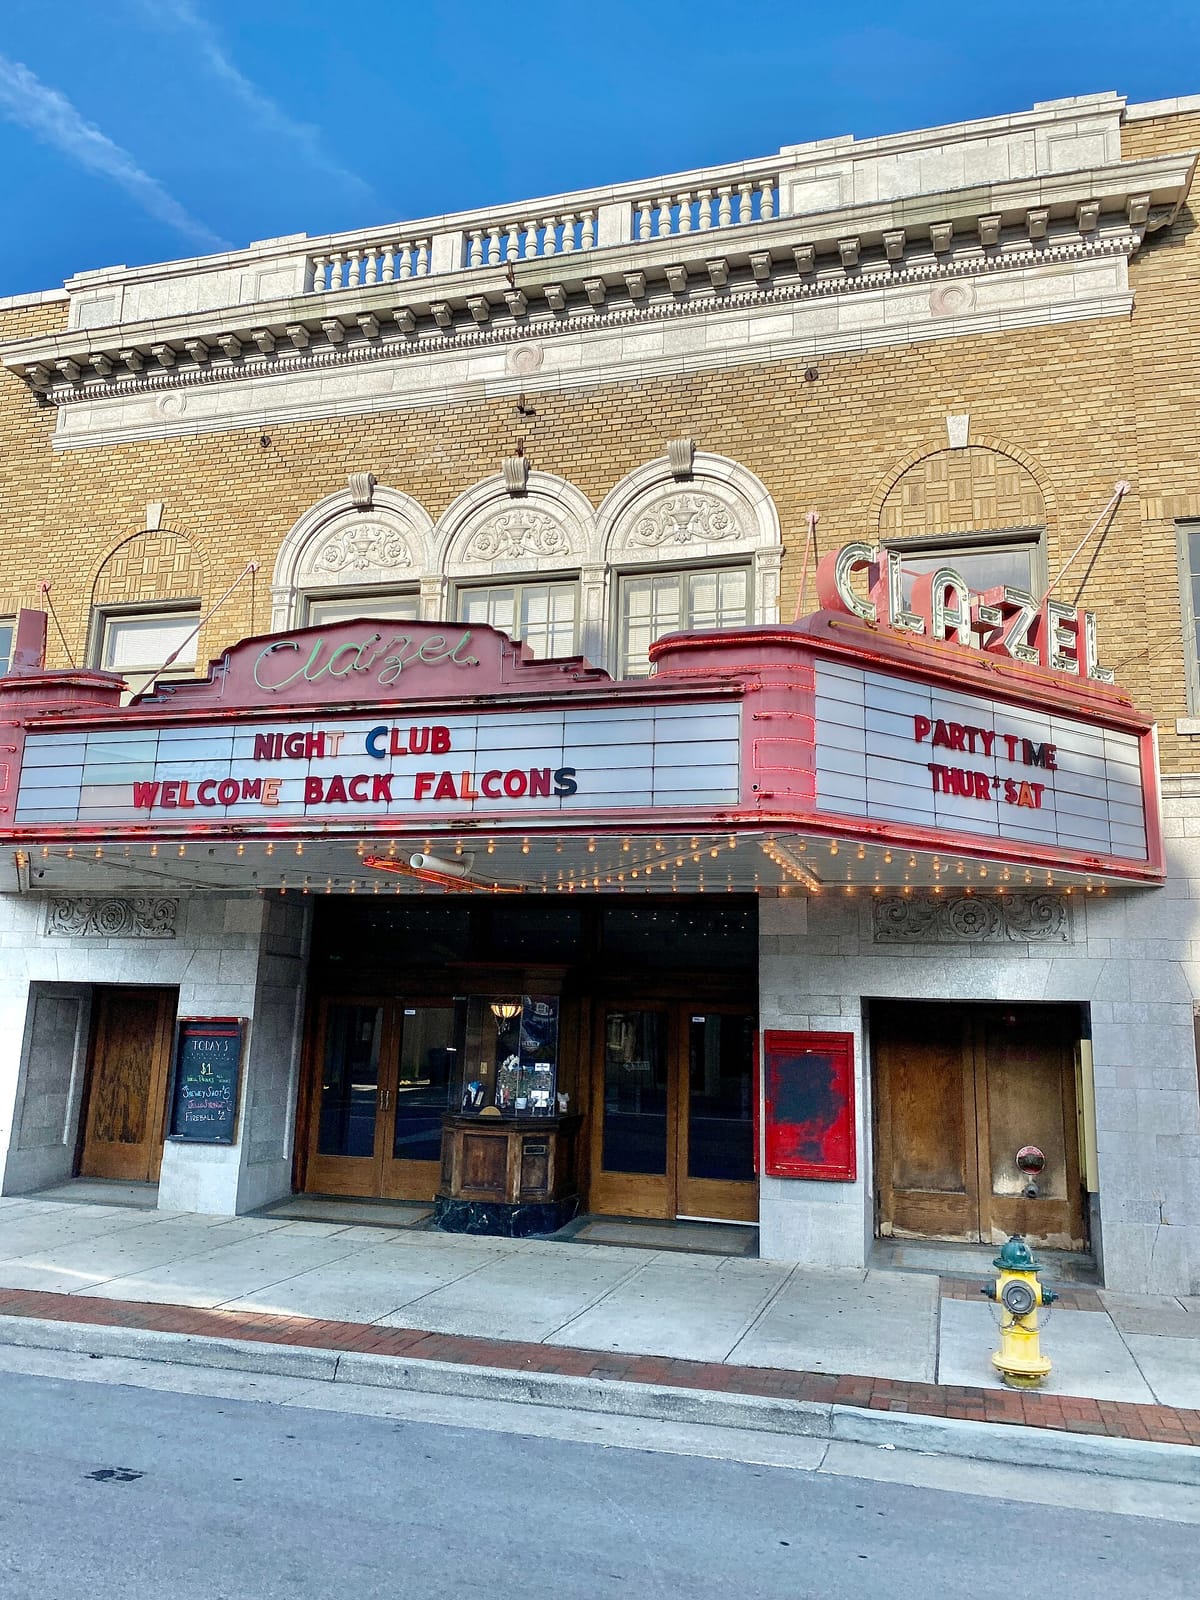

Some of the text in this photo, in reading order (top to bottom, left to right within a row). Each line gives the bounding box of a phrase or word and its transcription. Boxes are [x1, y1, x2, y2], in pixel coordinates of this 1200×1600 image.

[826, 541, 1115, 686] CLA-ZEL
[253, 725, 452, 761] NIGHT CLUB
[914, 714, 1058, 771] PARTY TIME
[133, 767, 578, 809] WELCOME BACK FALCONS
[200, 1062, 214, 1075] $1
